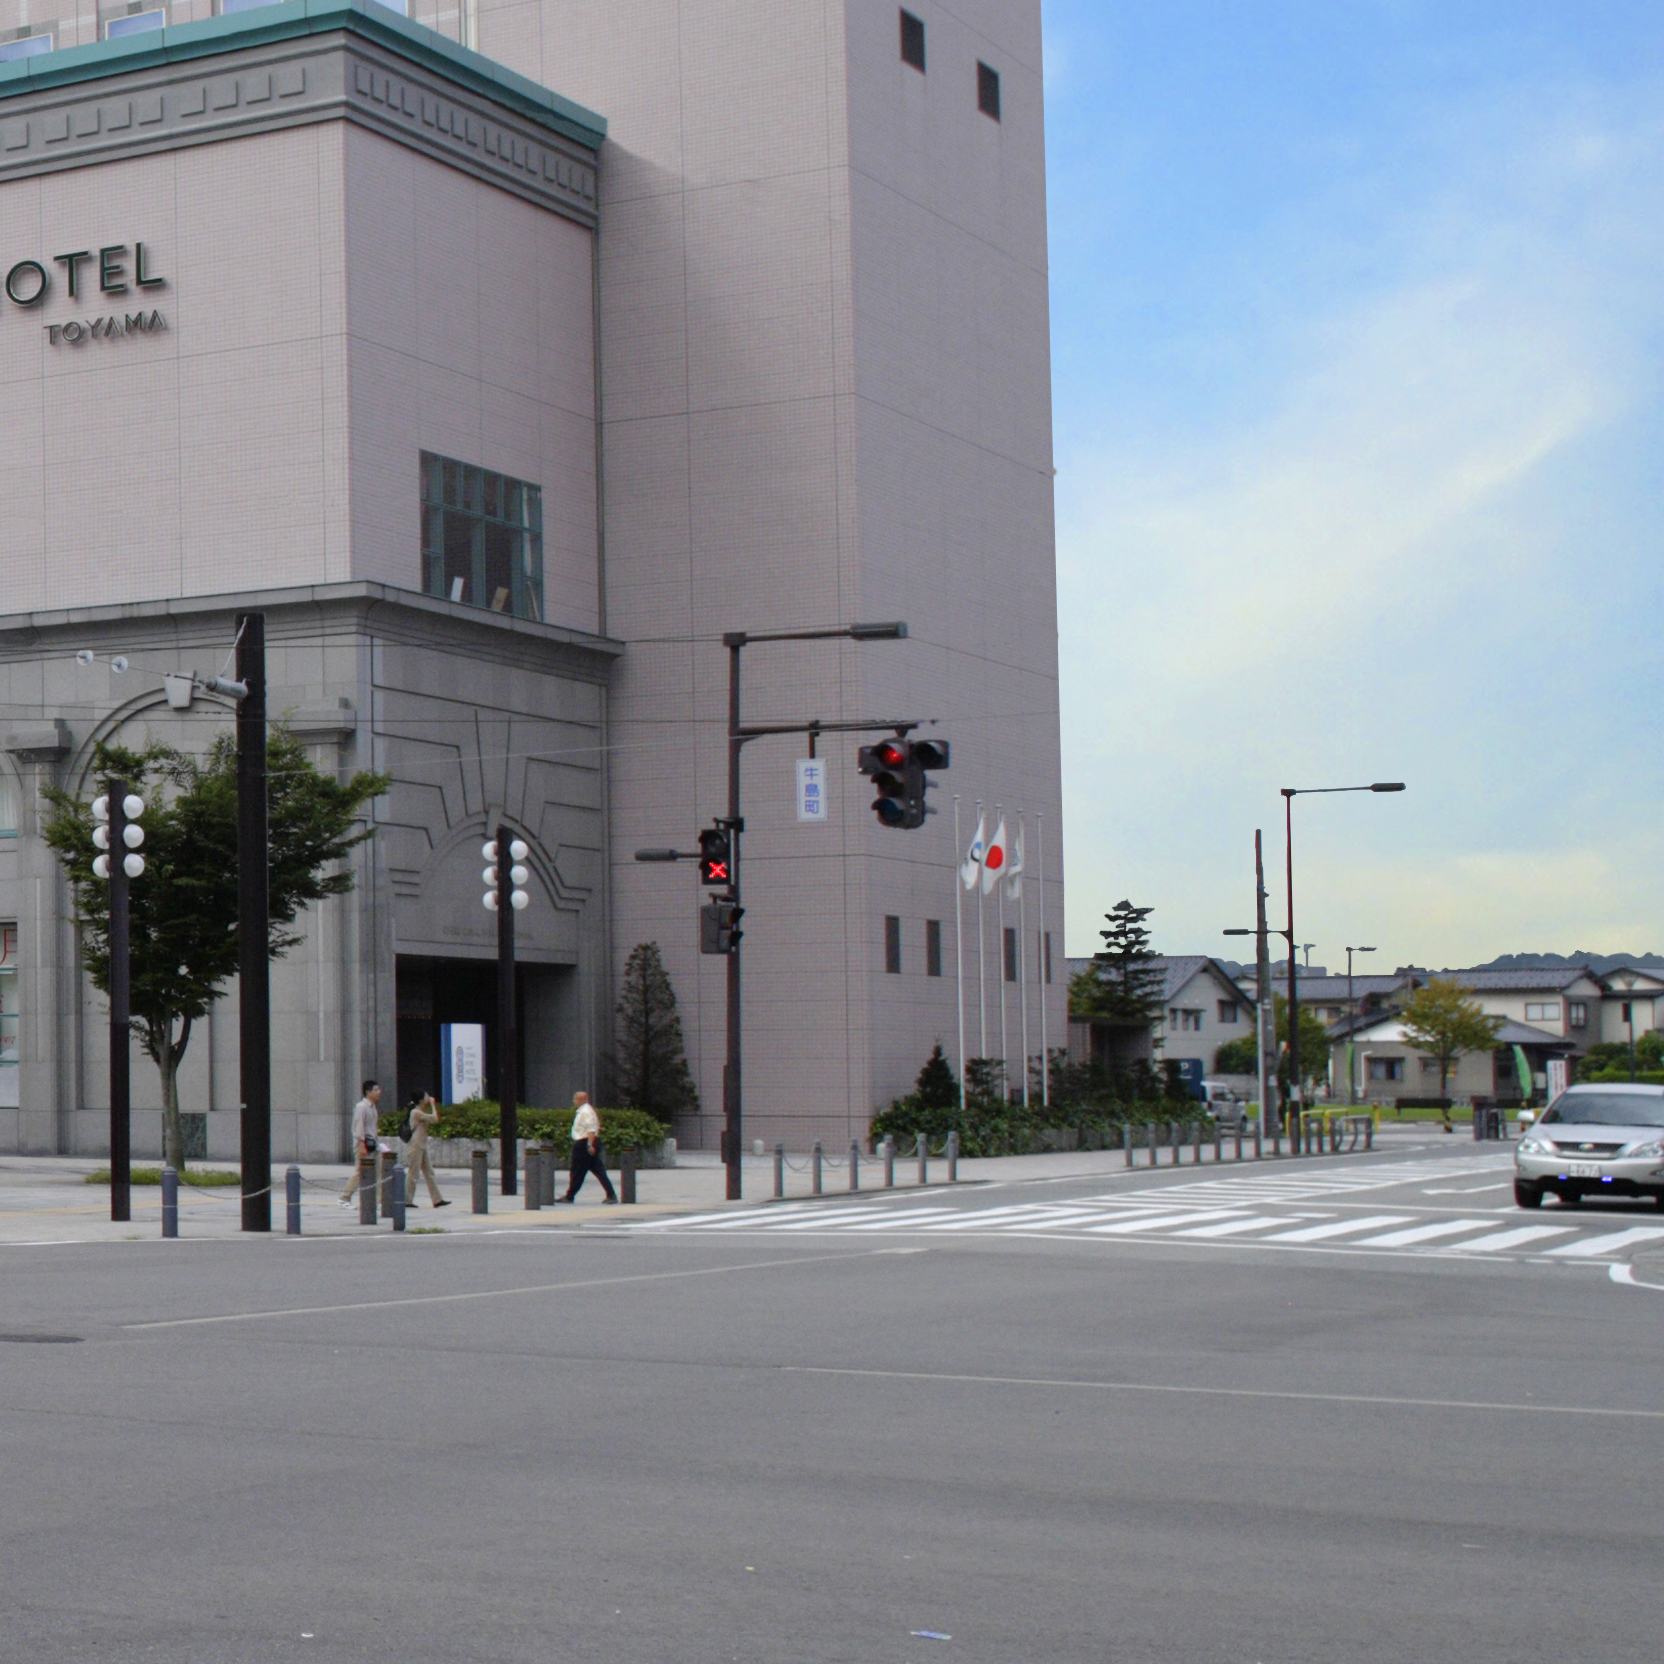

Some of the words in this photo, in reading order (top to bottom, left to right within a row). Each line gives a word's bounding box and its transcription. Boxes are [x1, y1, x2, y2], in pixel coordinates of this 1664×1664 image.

[44, 309, 165, 346] TOYAMA
[804, 767, 820, 814] 牛島町
